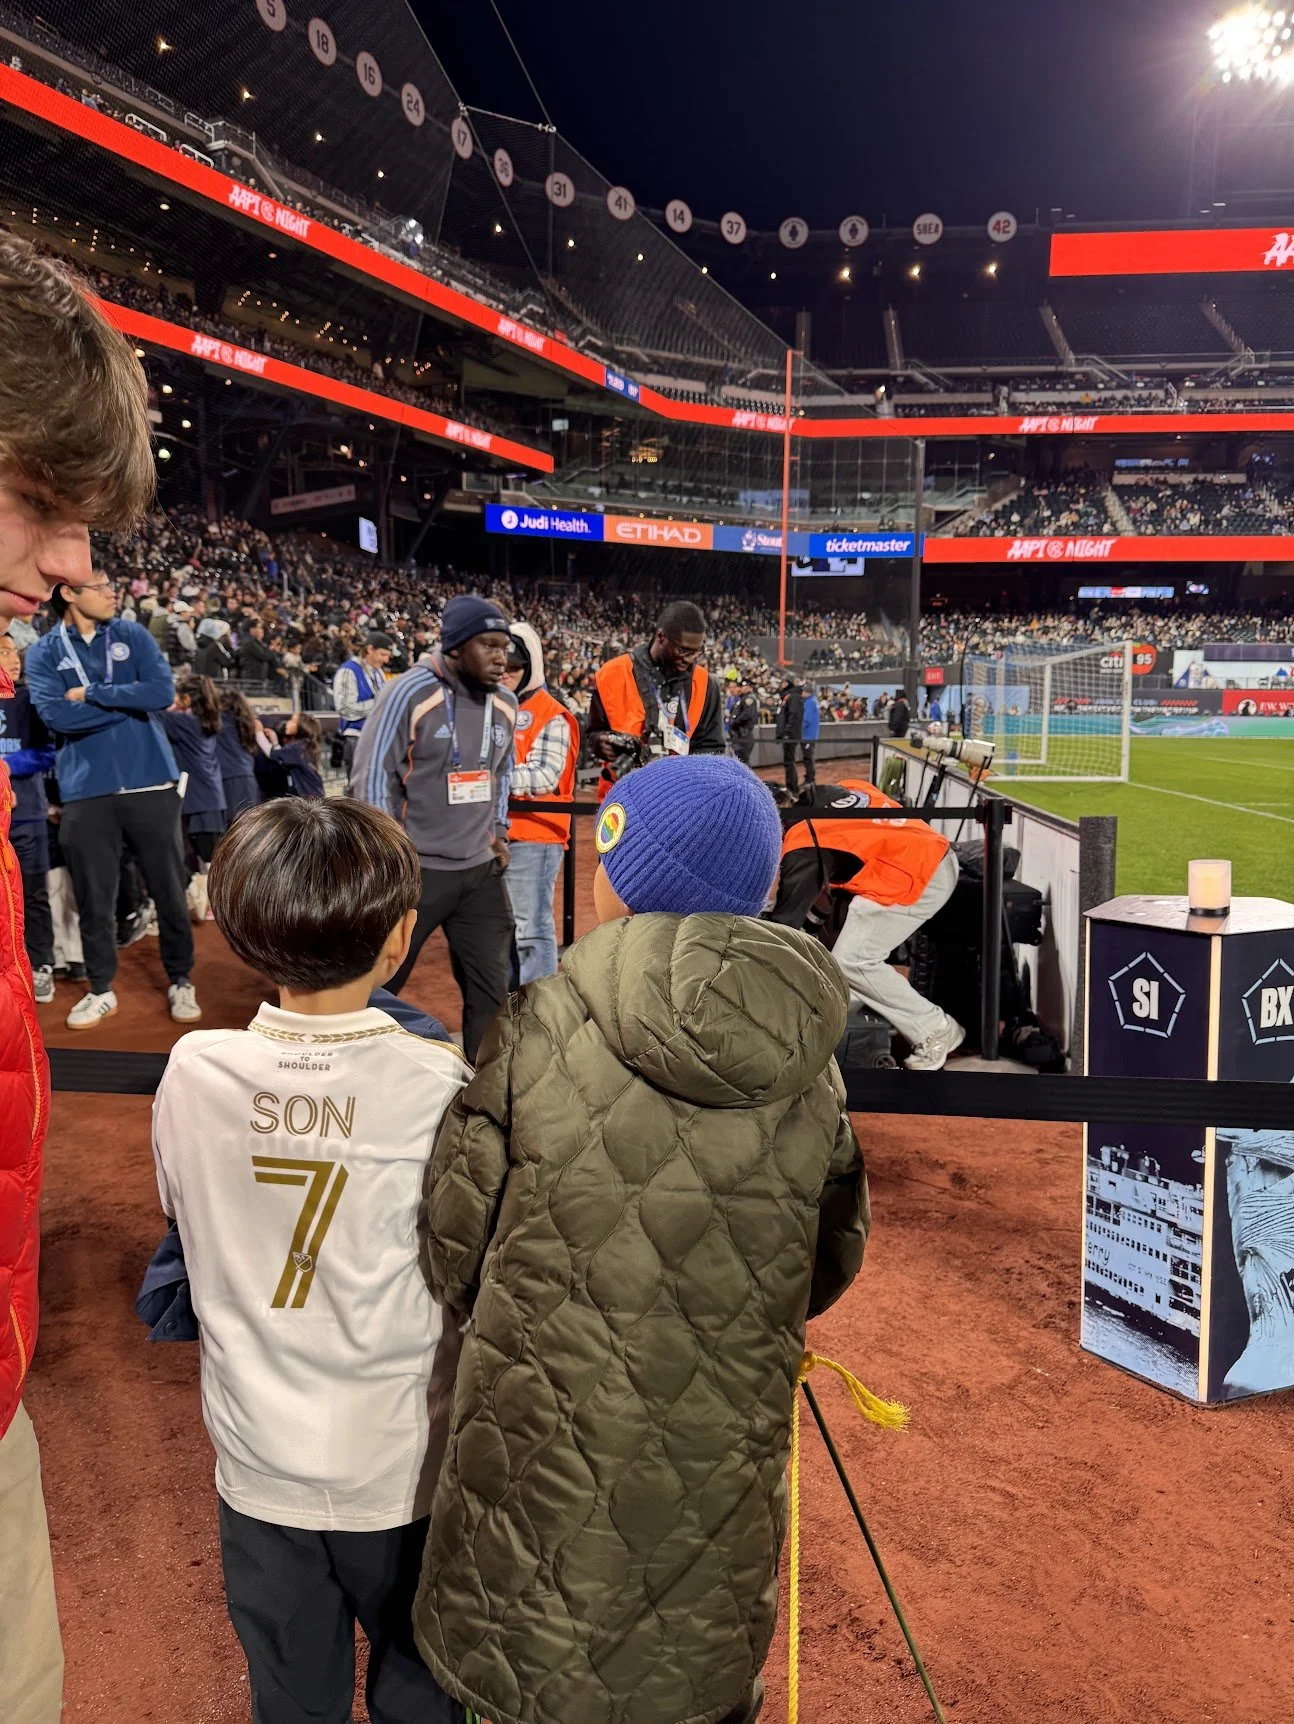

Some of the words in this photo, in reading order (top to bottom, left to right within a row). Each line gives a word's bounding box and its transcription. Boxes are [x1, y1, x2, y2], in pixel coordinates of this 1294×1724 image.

[266, 0, 276, 17] 5
[315, 29, 329, 54] 18
[363, 63, 376, 86] 16
[406, 92, 420, 117] 24
[457, 128, 468, 148] 17
[553, 182, 567, 198] 31
[614, 196, 628, 212] 41
[672, 208, 685, 224] 14
[726, 220, 741, 236] 37
[916, 221, 940, 236] SHEA
[992, 219, 1011, 235] 42
[519, 513, 549, 530] Judi
[615, 521, 703, 544] ETIHAD
[825, 537, 911, 553] ticketmaster
[1007, 538, 1049, 560] AAPI
[1065, 539, 1117, 558] NIGHT
[1132, 977, 1160, 1021] SI
[1259, 985, 1294, 1029] BX
[278, 1061, 331, 1072] SHOULDER
[250, 1091, 356, 1139] SON
[251, 1155, 350, 1309] 7
